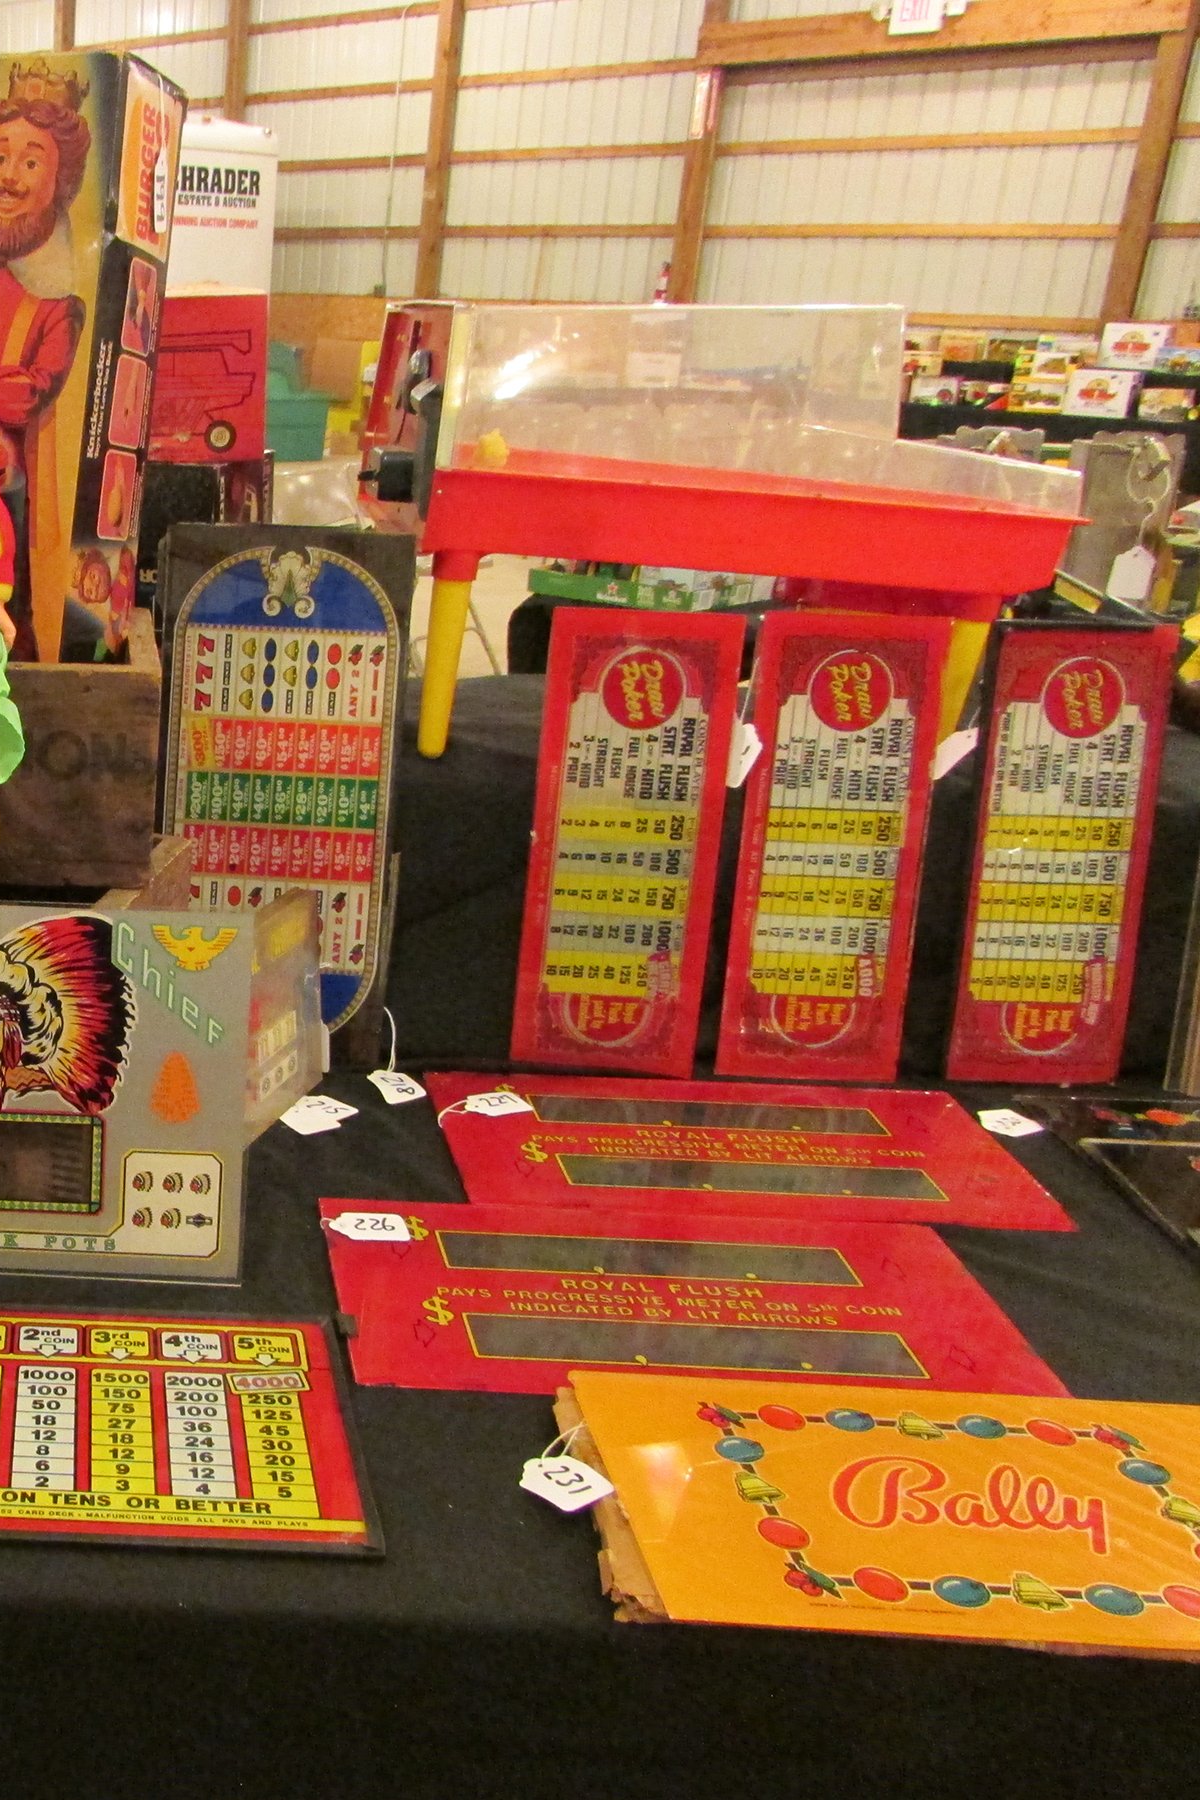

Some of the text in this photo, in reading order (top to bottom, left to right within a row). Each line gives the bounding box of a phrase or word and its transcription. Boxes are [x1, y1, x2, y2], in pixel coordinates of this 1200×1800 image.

[135, 102, 157, 242] BURGER
[176, 166, 261, 196] HRADER
[177, 194, 212, 206] ESTATE
[222, 198, 257, 208] AUCTION
[347, 685, 359, 717] ANY
[827, 664, 852, 722] Poker
[887, 718, 903, 758] ROYAL
[673, 717, 697, 801] ROYAL FLUSH
[801, 738, 816, 789] STRAIGHT
[831, 738, 849, 800] FULL HOUSE
[1111, 724, 1134, 809] ROYAL FLUSH
[882, 766, 898, 802] FLUSH
[876, 815, 892, 842] 250
[872, 850, 888, 877] 500
[863, 921, 878, 955] 1000
[635, 1130, 808, 1145] ROYAL FLUSH
[735, 1143, 926, 1158] METER COIN
[785, 1153, 872, 1165] ARROWS
[353, 1217, 397, 1232] 226
[44, 1233, 118, 1251] POTS
[560, 1278, 764, 1298] ROYAL FLUSH
[436, 1286, 493, 1299] PAYS
[503, 1289, 667, 1306] PROGRESSIVE
[676, 1298, 766, 1311] METER
[770, 1301, 799, 1312] ON
[845, 1305, 904, 1318] COIN
[509, 1301, 839, 1326] INDICATED BY LIT ARROWS
[23, 1328, 62, 1342] 2nd
[44, 1336, 75, 1345] COIN
[94, 1331, 130, 1344] 3rd
[114, 1339, 146, 1348] COIN
[164, 1335, 202, 1348] 4th
[237, 1337, 273, 1350] 5th
[186, 1342, 218, 1351] COIN
[258, 1345, 290, 1354] COIN
[20, 1369, 75, 1381] 1000
[93, 1373, 149, 1385] 1500
[166, 1376, 223, 1388] 2000
[235, 1376, 300, 1389] 4000
[27, 1385, 68, 1396] 100
[100, 1388, 142, 1400] 150
[543, 1465, 592, 1495] 231
[1, 1490, 37, 1504] ON
[48, 1492, 112, 1508] TENS
[126, 1495, 161, 1510] OR
[174, 1498, 272, 1515] BETTER
[830, 1454, 1111, 1556] Bally
[86, 1511, 190, 1523] MALFUNCTION VOIDS
